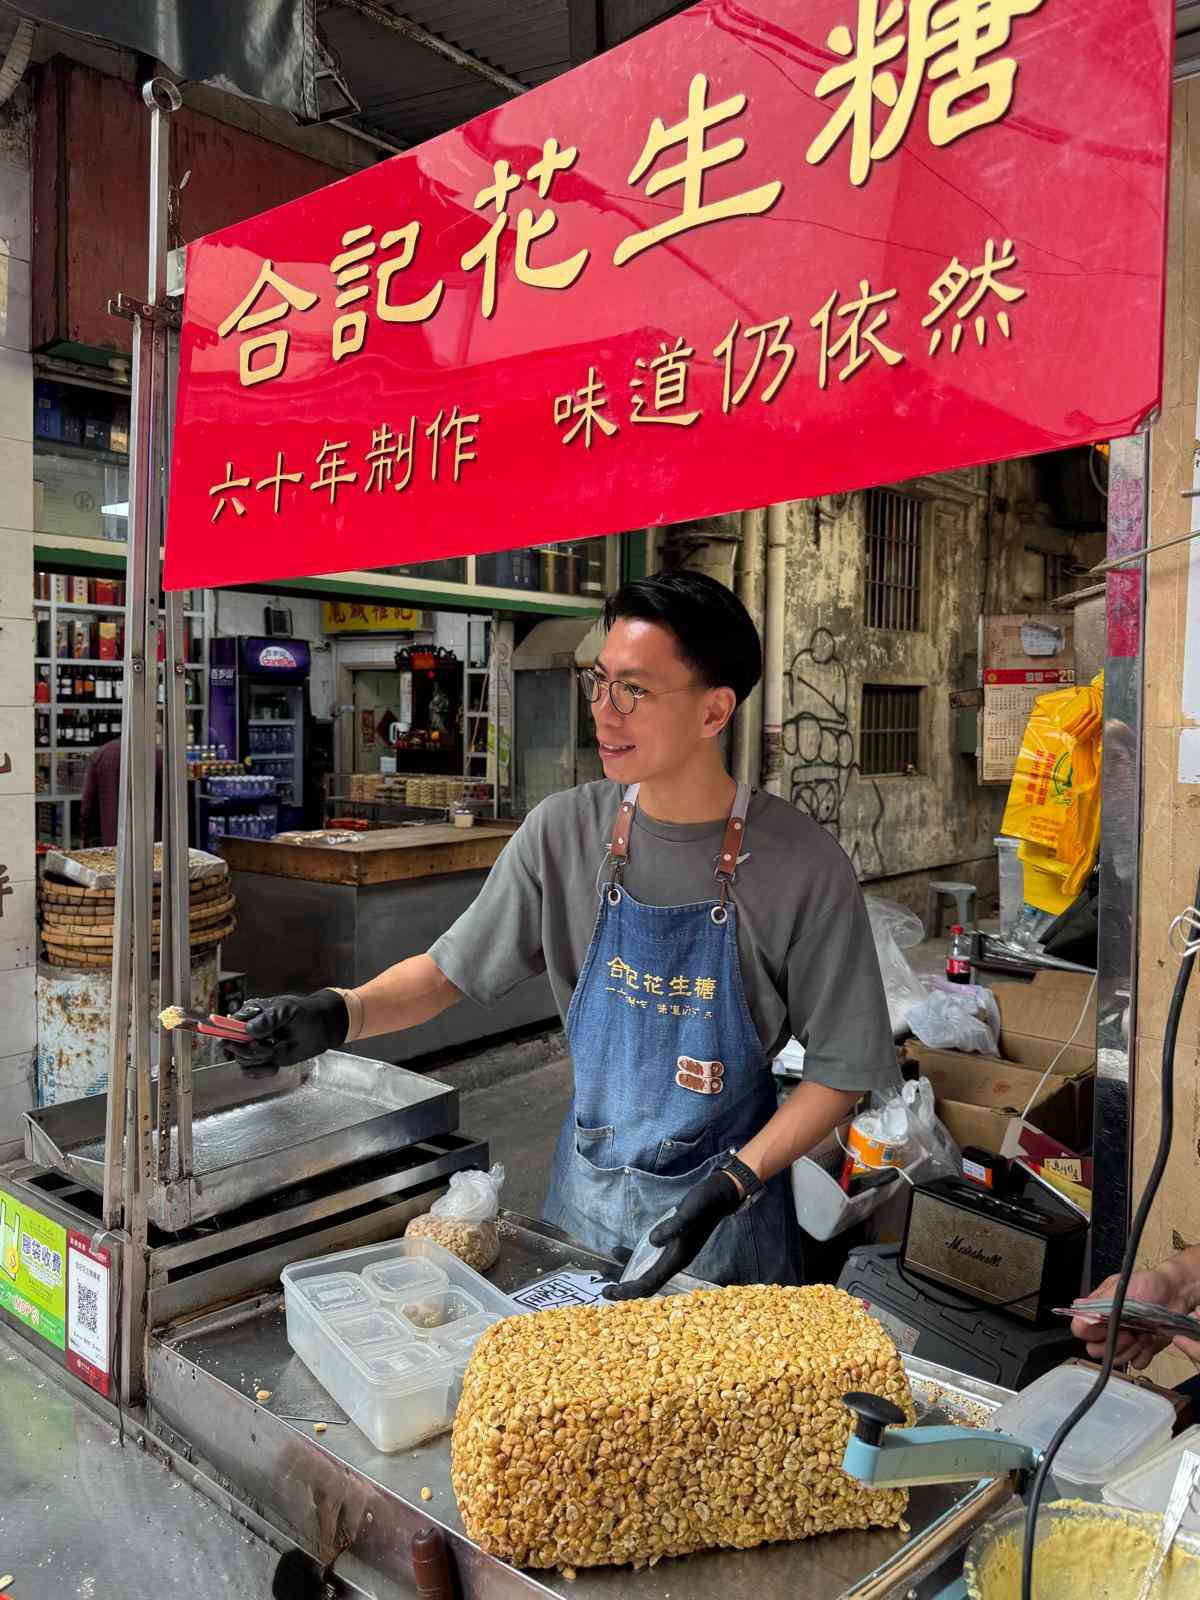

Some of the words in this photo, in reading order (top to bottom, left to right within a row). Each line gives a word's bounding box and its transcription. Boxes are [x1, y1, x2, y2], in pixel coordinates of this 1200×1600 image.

[218, 0, 1042, 388] 合記花生糖
[553, 238, 1026, 450] 味道仍依然
[207, 404, 481, 526] 六十年制作
[944, 1234, 1003, 1267] Marshall
